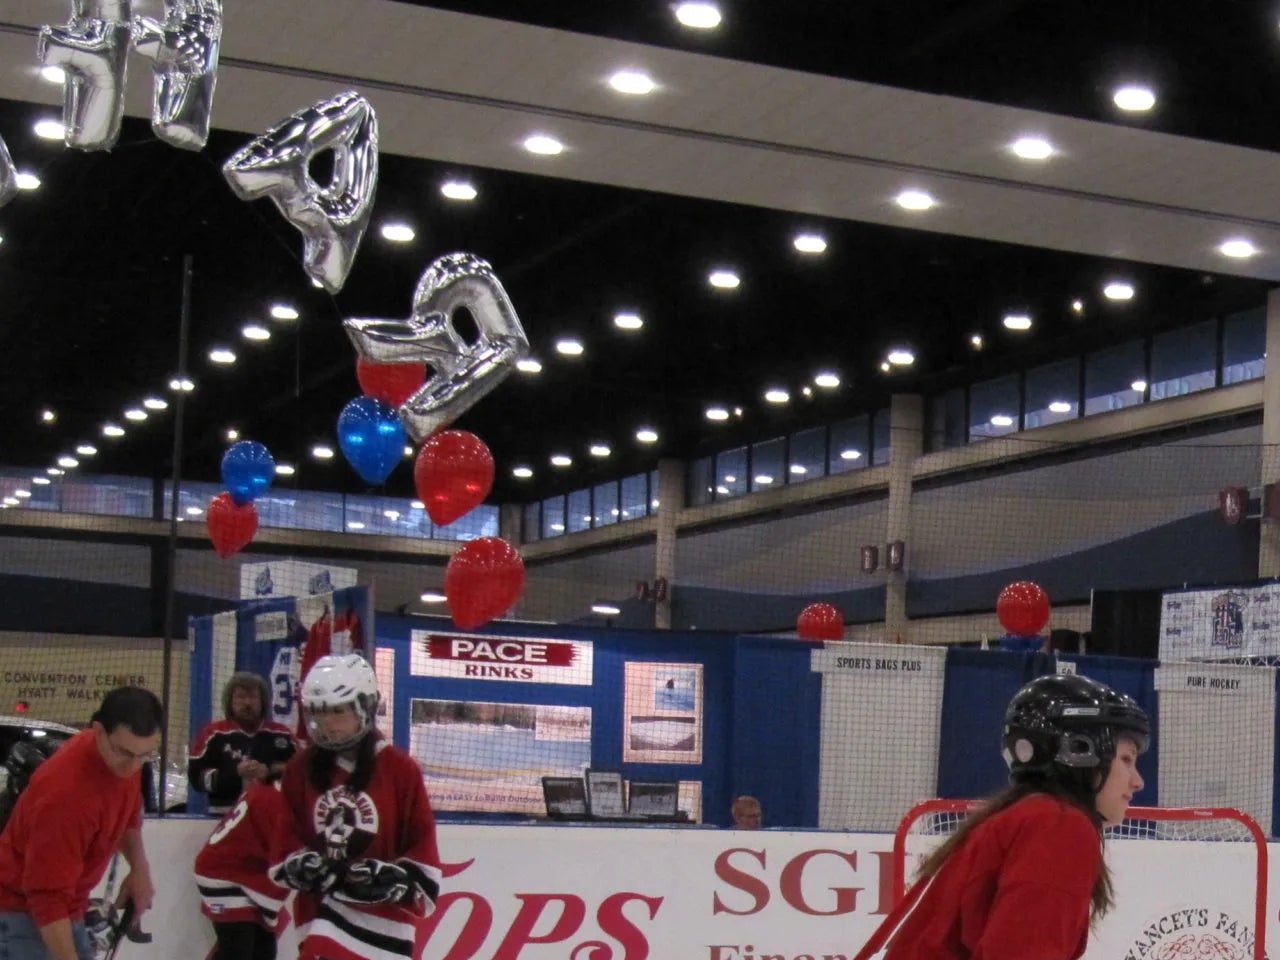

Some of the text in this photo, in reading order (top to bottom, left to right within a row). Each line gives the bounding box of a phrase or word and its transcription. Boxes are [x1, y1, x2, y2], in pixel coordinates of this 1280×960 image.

[451, 638, 548, 663] PACE
[464, 664, 534, 680] RINKS
[836, 657, 922, 672] SPORTS BAGS PLUS
[4, 672, 146, 687] CONVENTION CENTER
[1187, 676, 1241, 690] PURE HOCKEY
[18, 686, 56, 700] HYATT
